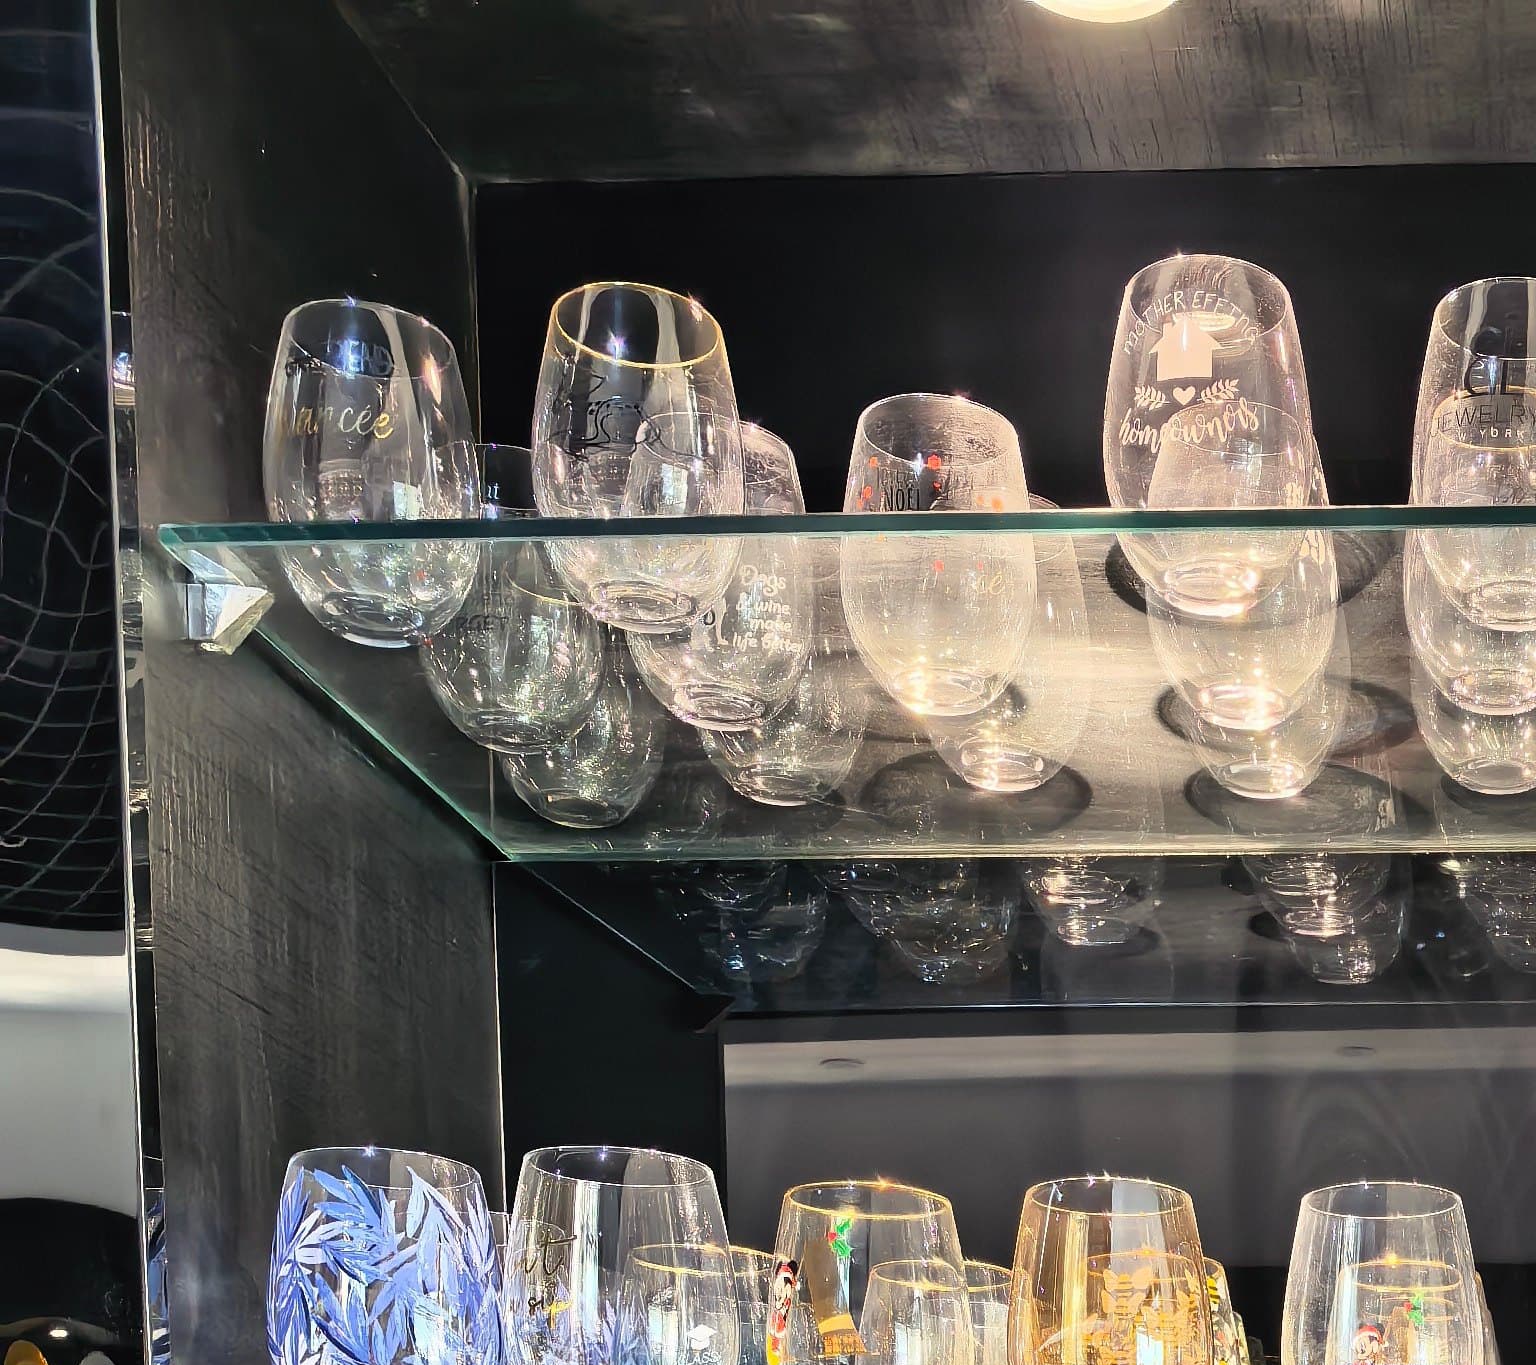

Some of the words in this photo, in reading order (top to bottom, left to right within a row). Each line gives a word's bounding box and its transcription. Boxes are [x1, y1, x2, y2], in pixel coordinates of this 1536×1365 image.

[1118, 397, 1259, 453] homeowners
[741, 564, 787, 597] Dogs
[757, 599, 792, 615] wine
[750, 616, 793, 634] make
[732, 631, 758, 652] life
